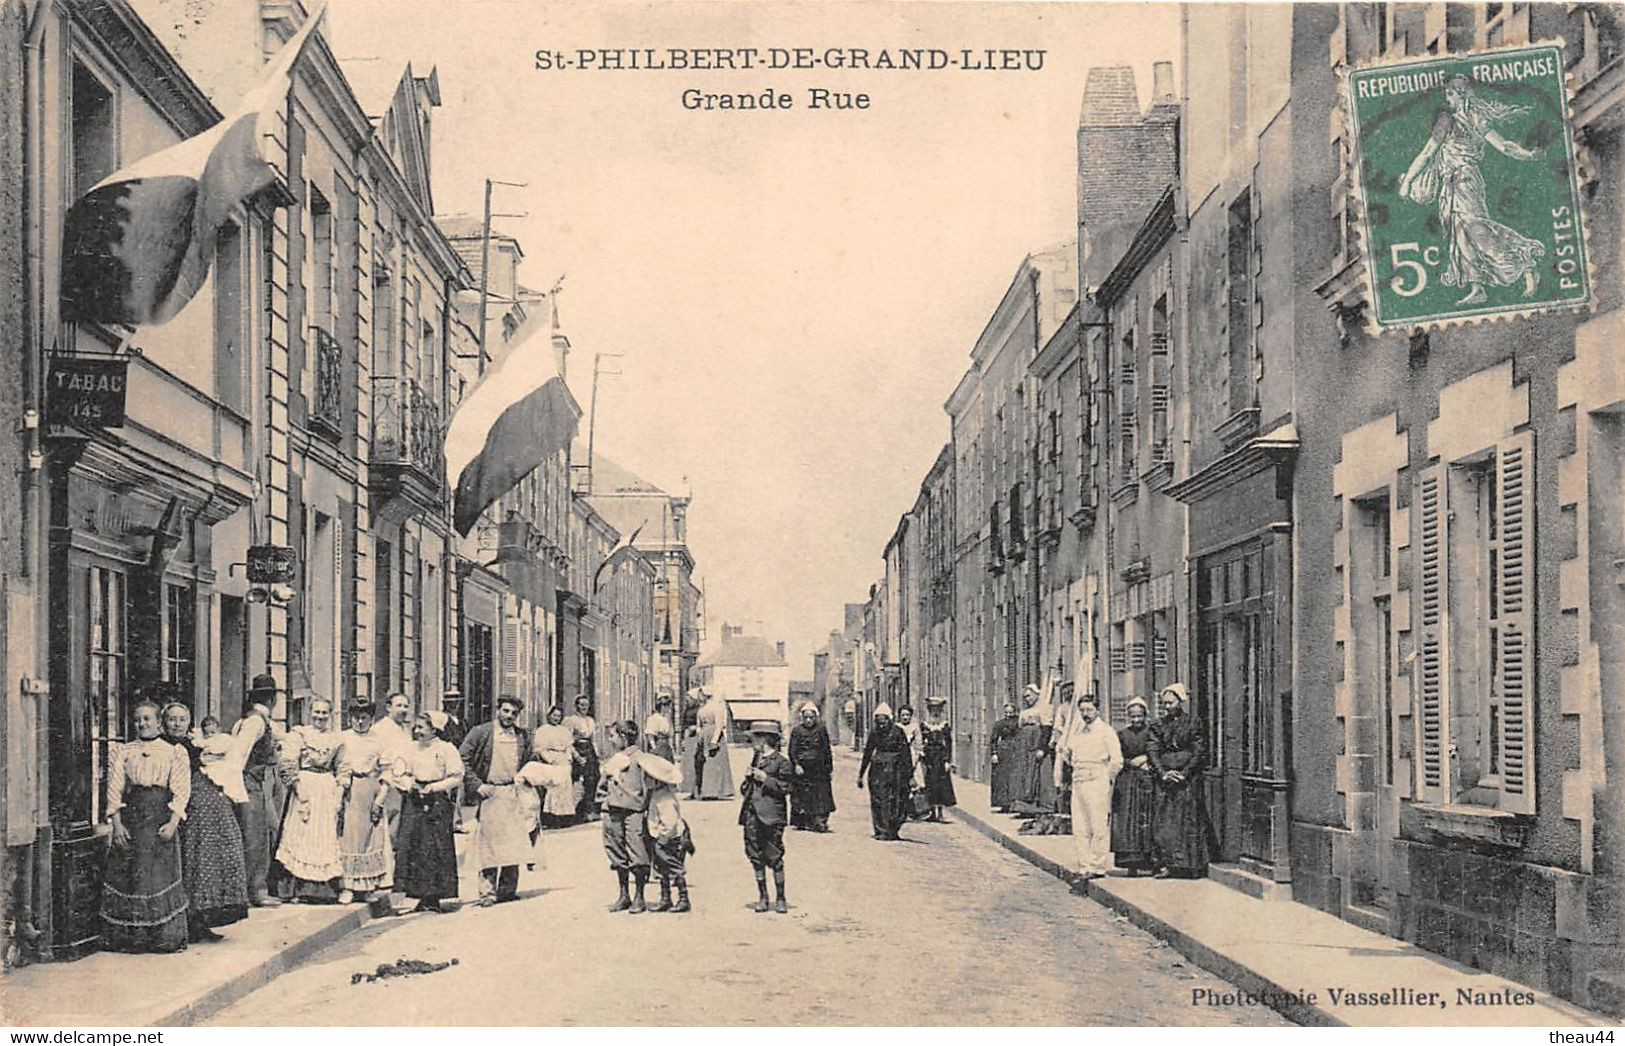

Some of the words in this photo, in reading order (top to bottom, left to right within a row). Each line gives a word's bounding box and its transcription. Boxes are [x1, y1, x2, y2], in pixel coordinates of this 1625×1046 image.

[1472, 57, 1555, 83] FRANÇAISE
[1551, 205, 1579, 290] POSTES
[54, 371, 123, 393] TABAC
